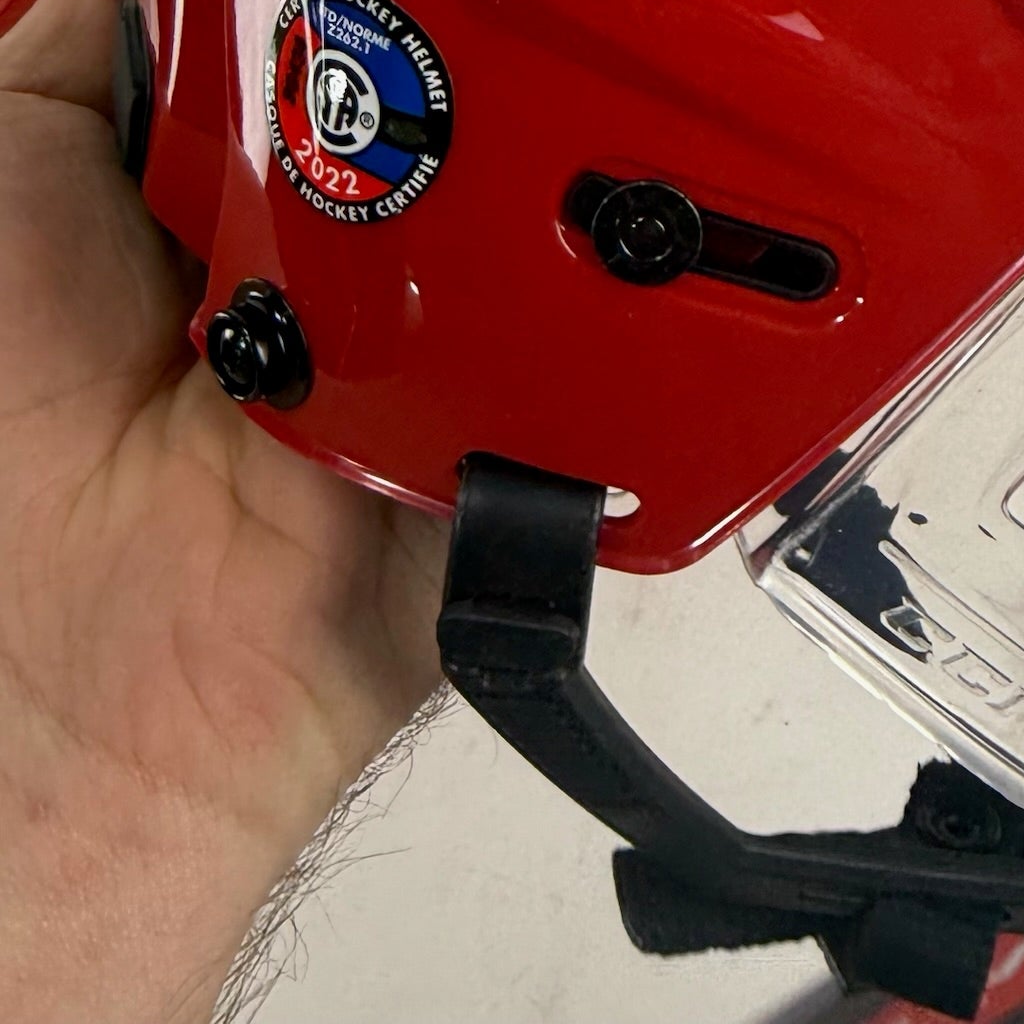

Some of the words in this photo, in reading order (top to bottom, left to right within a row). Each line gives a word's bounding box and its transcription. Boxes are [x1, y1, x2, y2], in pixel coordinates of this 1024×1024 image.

[401, 33, 448, 113] HELMET
[281, 156, 298, 183] DE
[300, 188, 369, 223] HOCKEY
[295, 138, 360, 195] 2022
